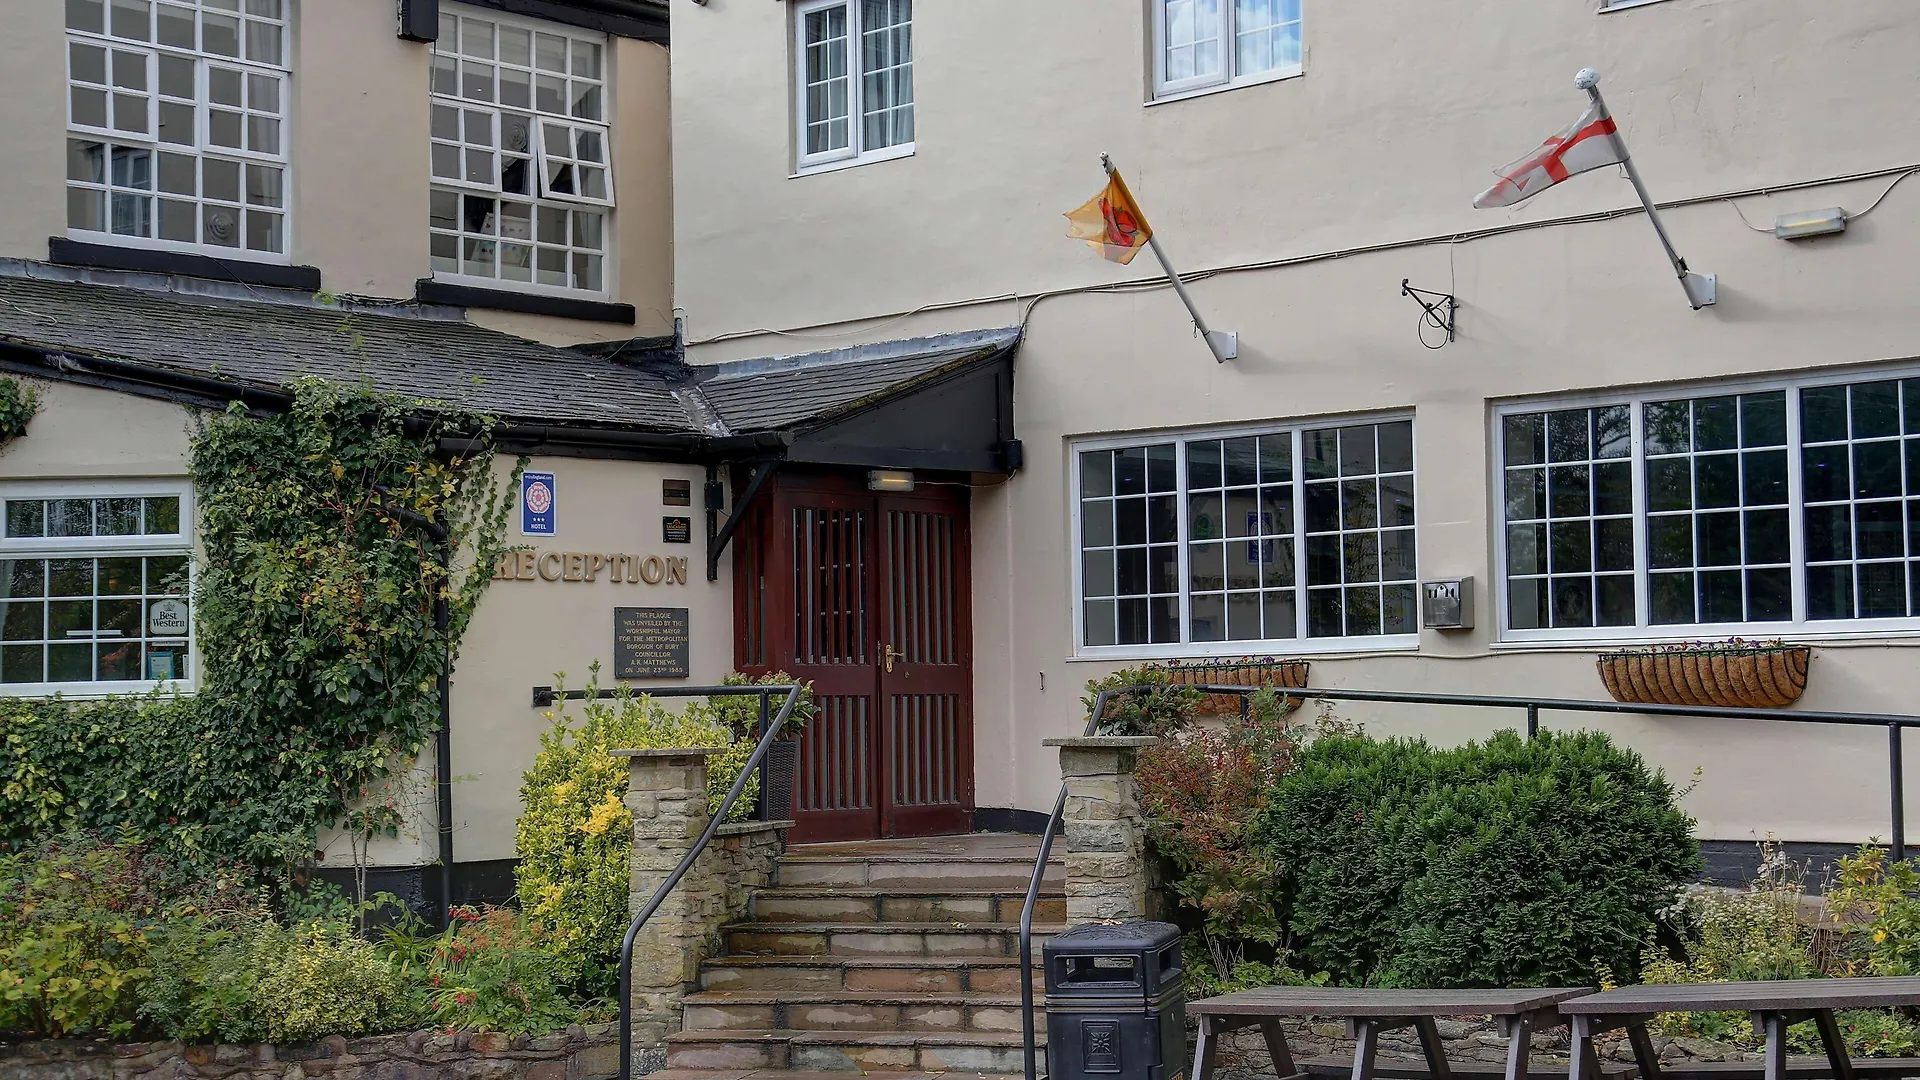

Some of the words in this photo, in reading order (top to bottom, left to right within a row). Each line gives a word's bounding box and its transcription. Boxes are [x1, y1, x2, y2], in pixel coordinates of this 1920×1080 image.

[491, 551, 689, 585] RECEPTION
[160, 611, 177, 620] Best
[152, 618, 185, 628] Western
